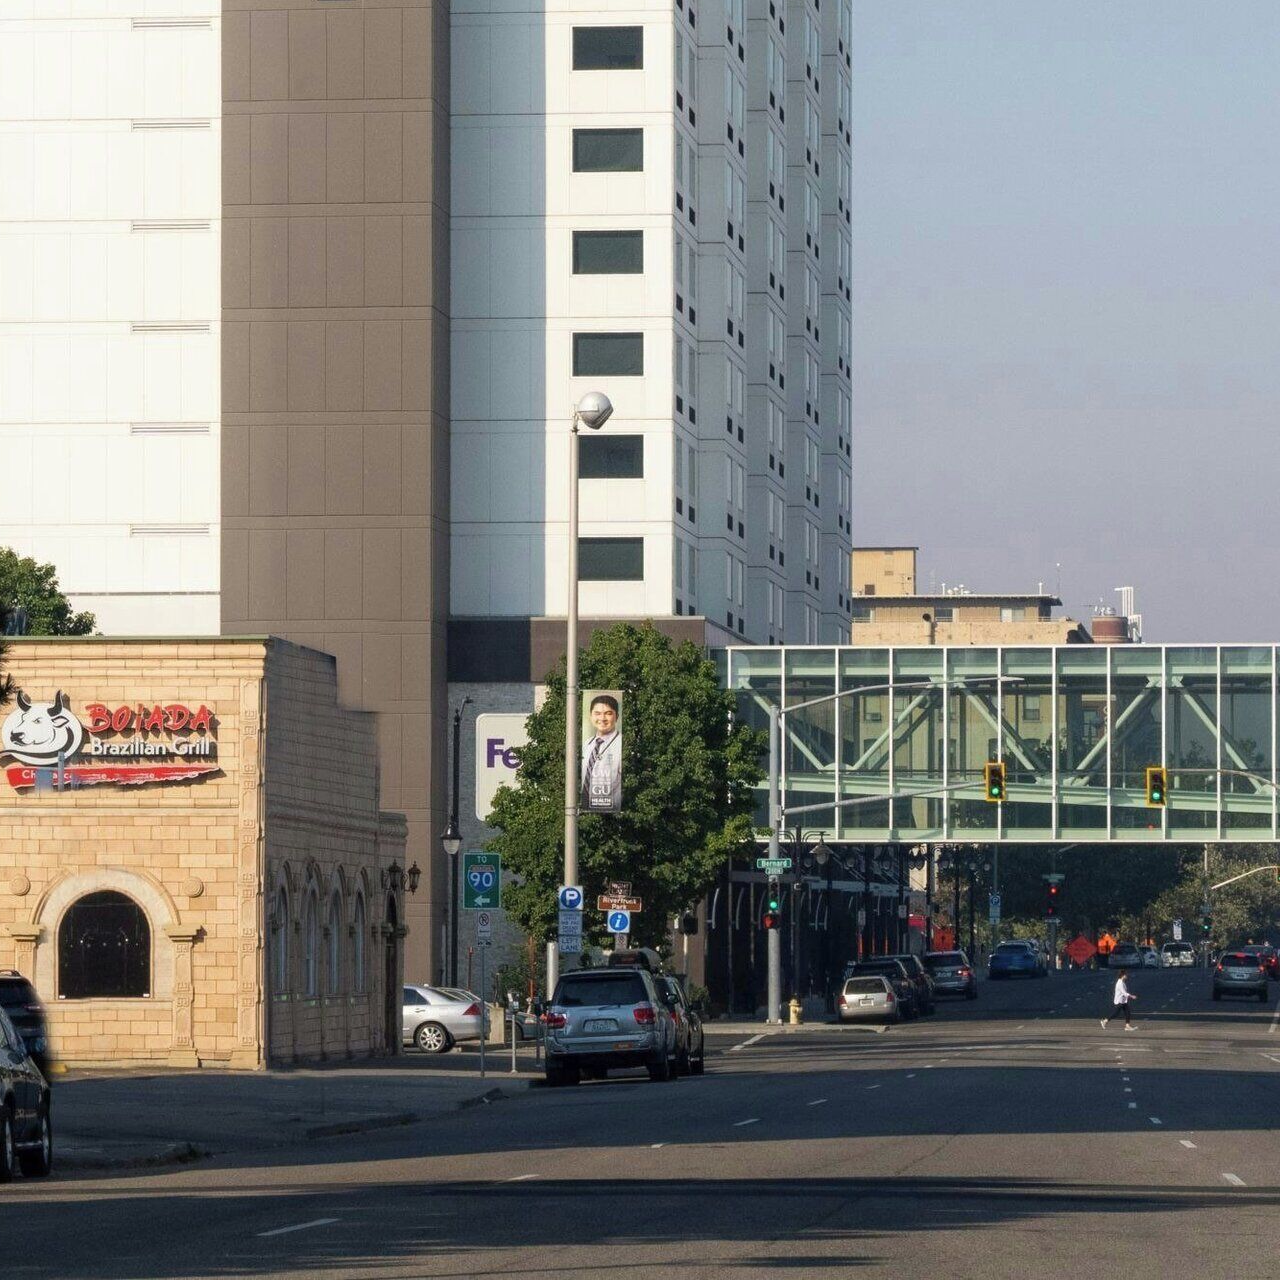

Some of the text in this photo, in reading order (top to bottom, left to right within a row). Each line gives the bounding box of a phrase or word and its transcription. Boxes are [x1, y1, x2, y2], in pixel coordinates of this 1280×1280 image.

[90, 736, 210, 756] Brazilian Grill
[592, 785, 611, 795] GU
[477, 855, 488, 863] TO
[470, 872, 493, 887] 90
